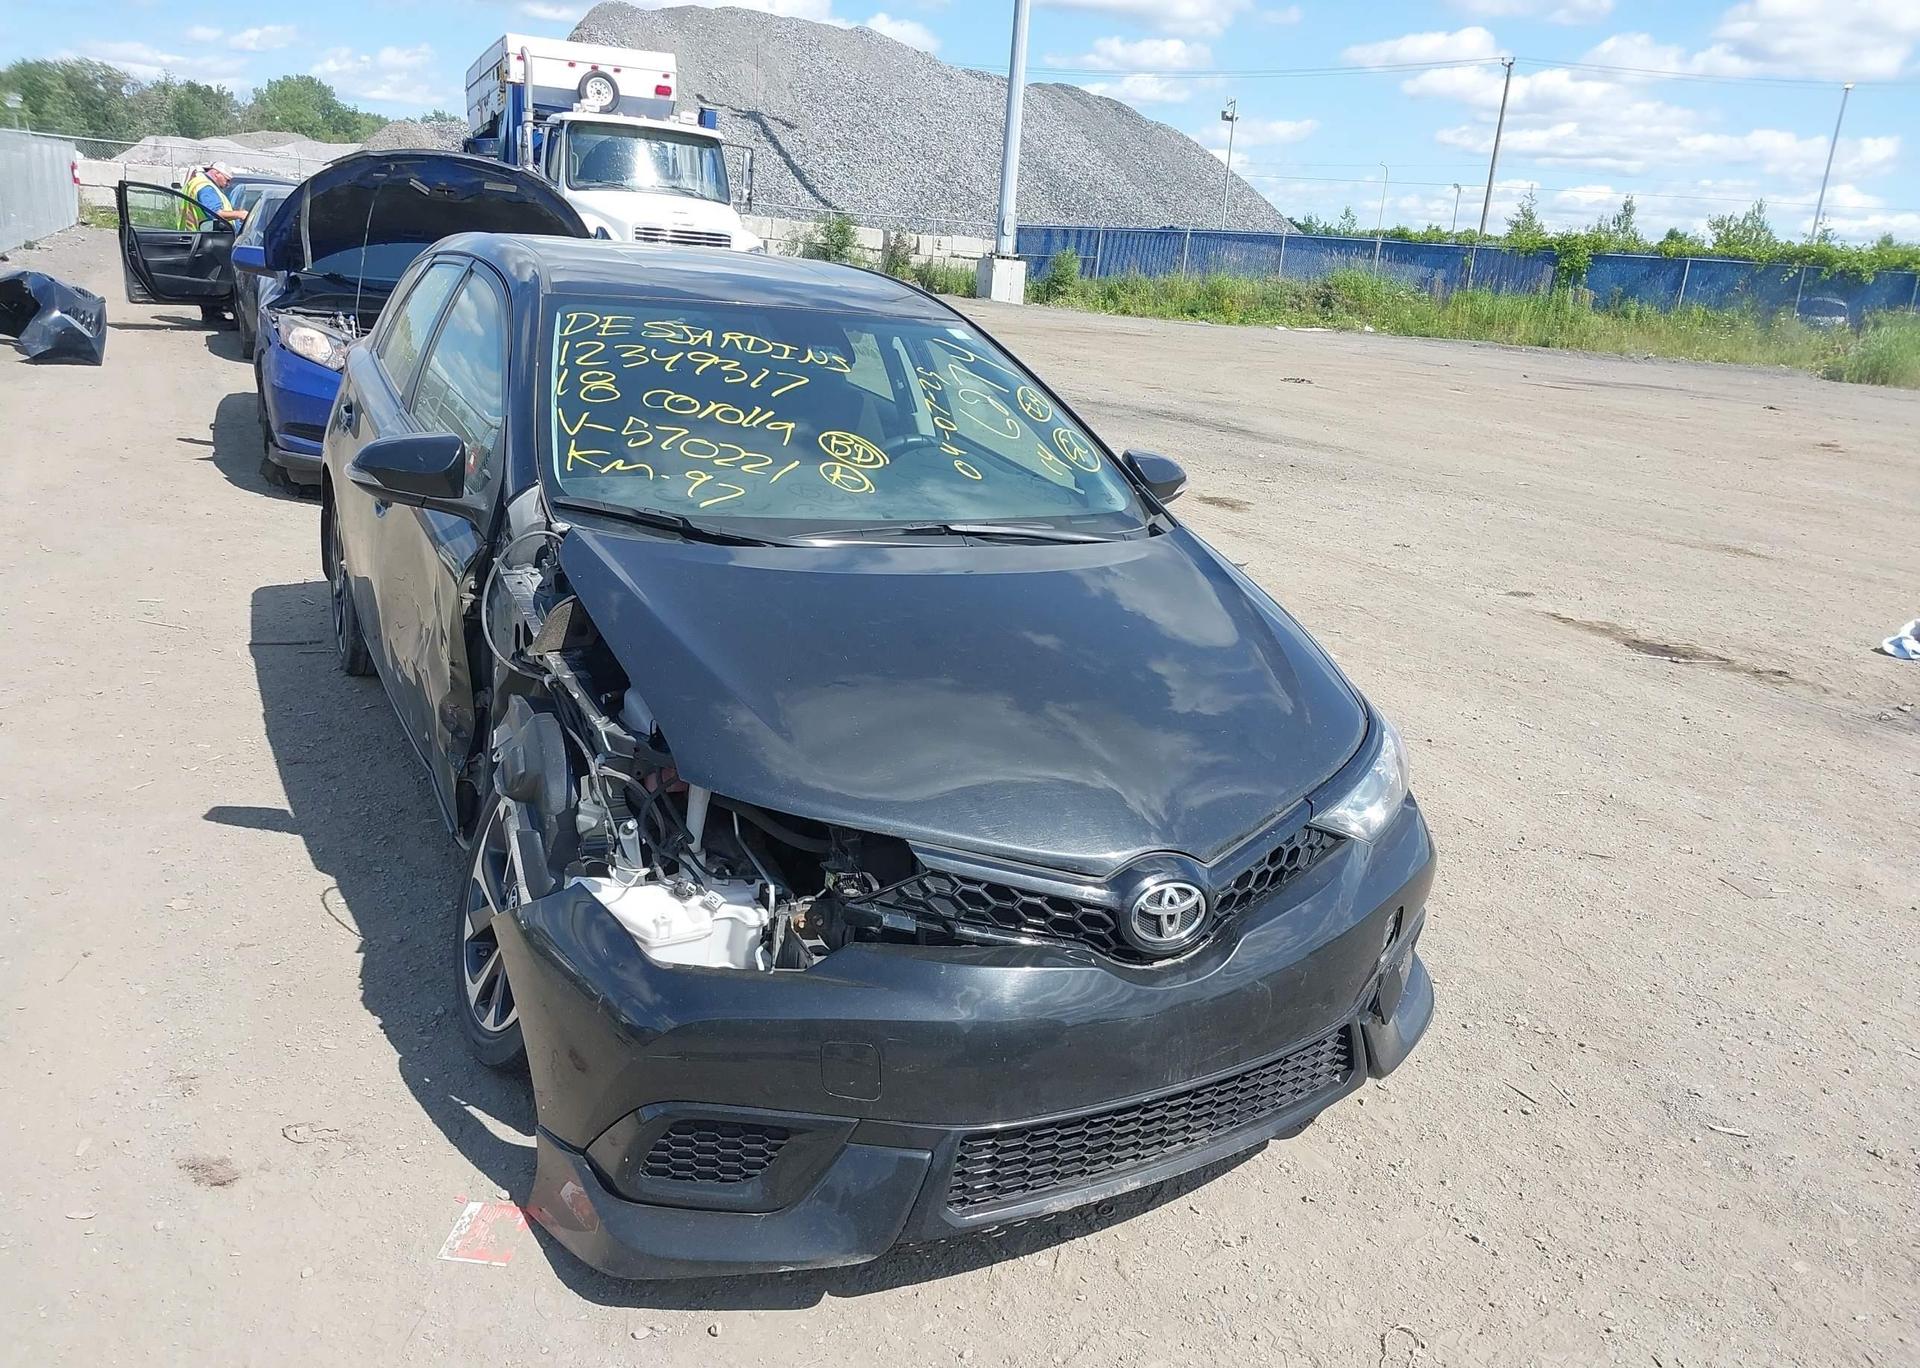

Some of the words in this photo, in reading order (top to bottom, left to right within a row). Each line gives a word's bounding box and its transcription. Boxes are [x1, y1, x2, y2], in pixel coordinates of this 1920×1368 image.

[556, 369, 621, 402] 18
[560, 341, 809, 397] 12349317
[828, 433, 877, 465] BD
